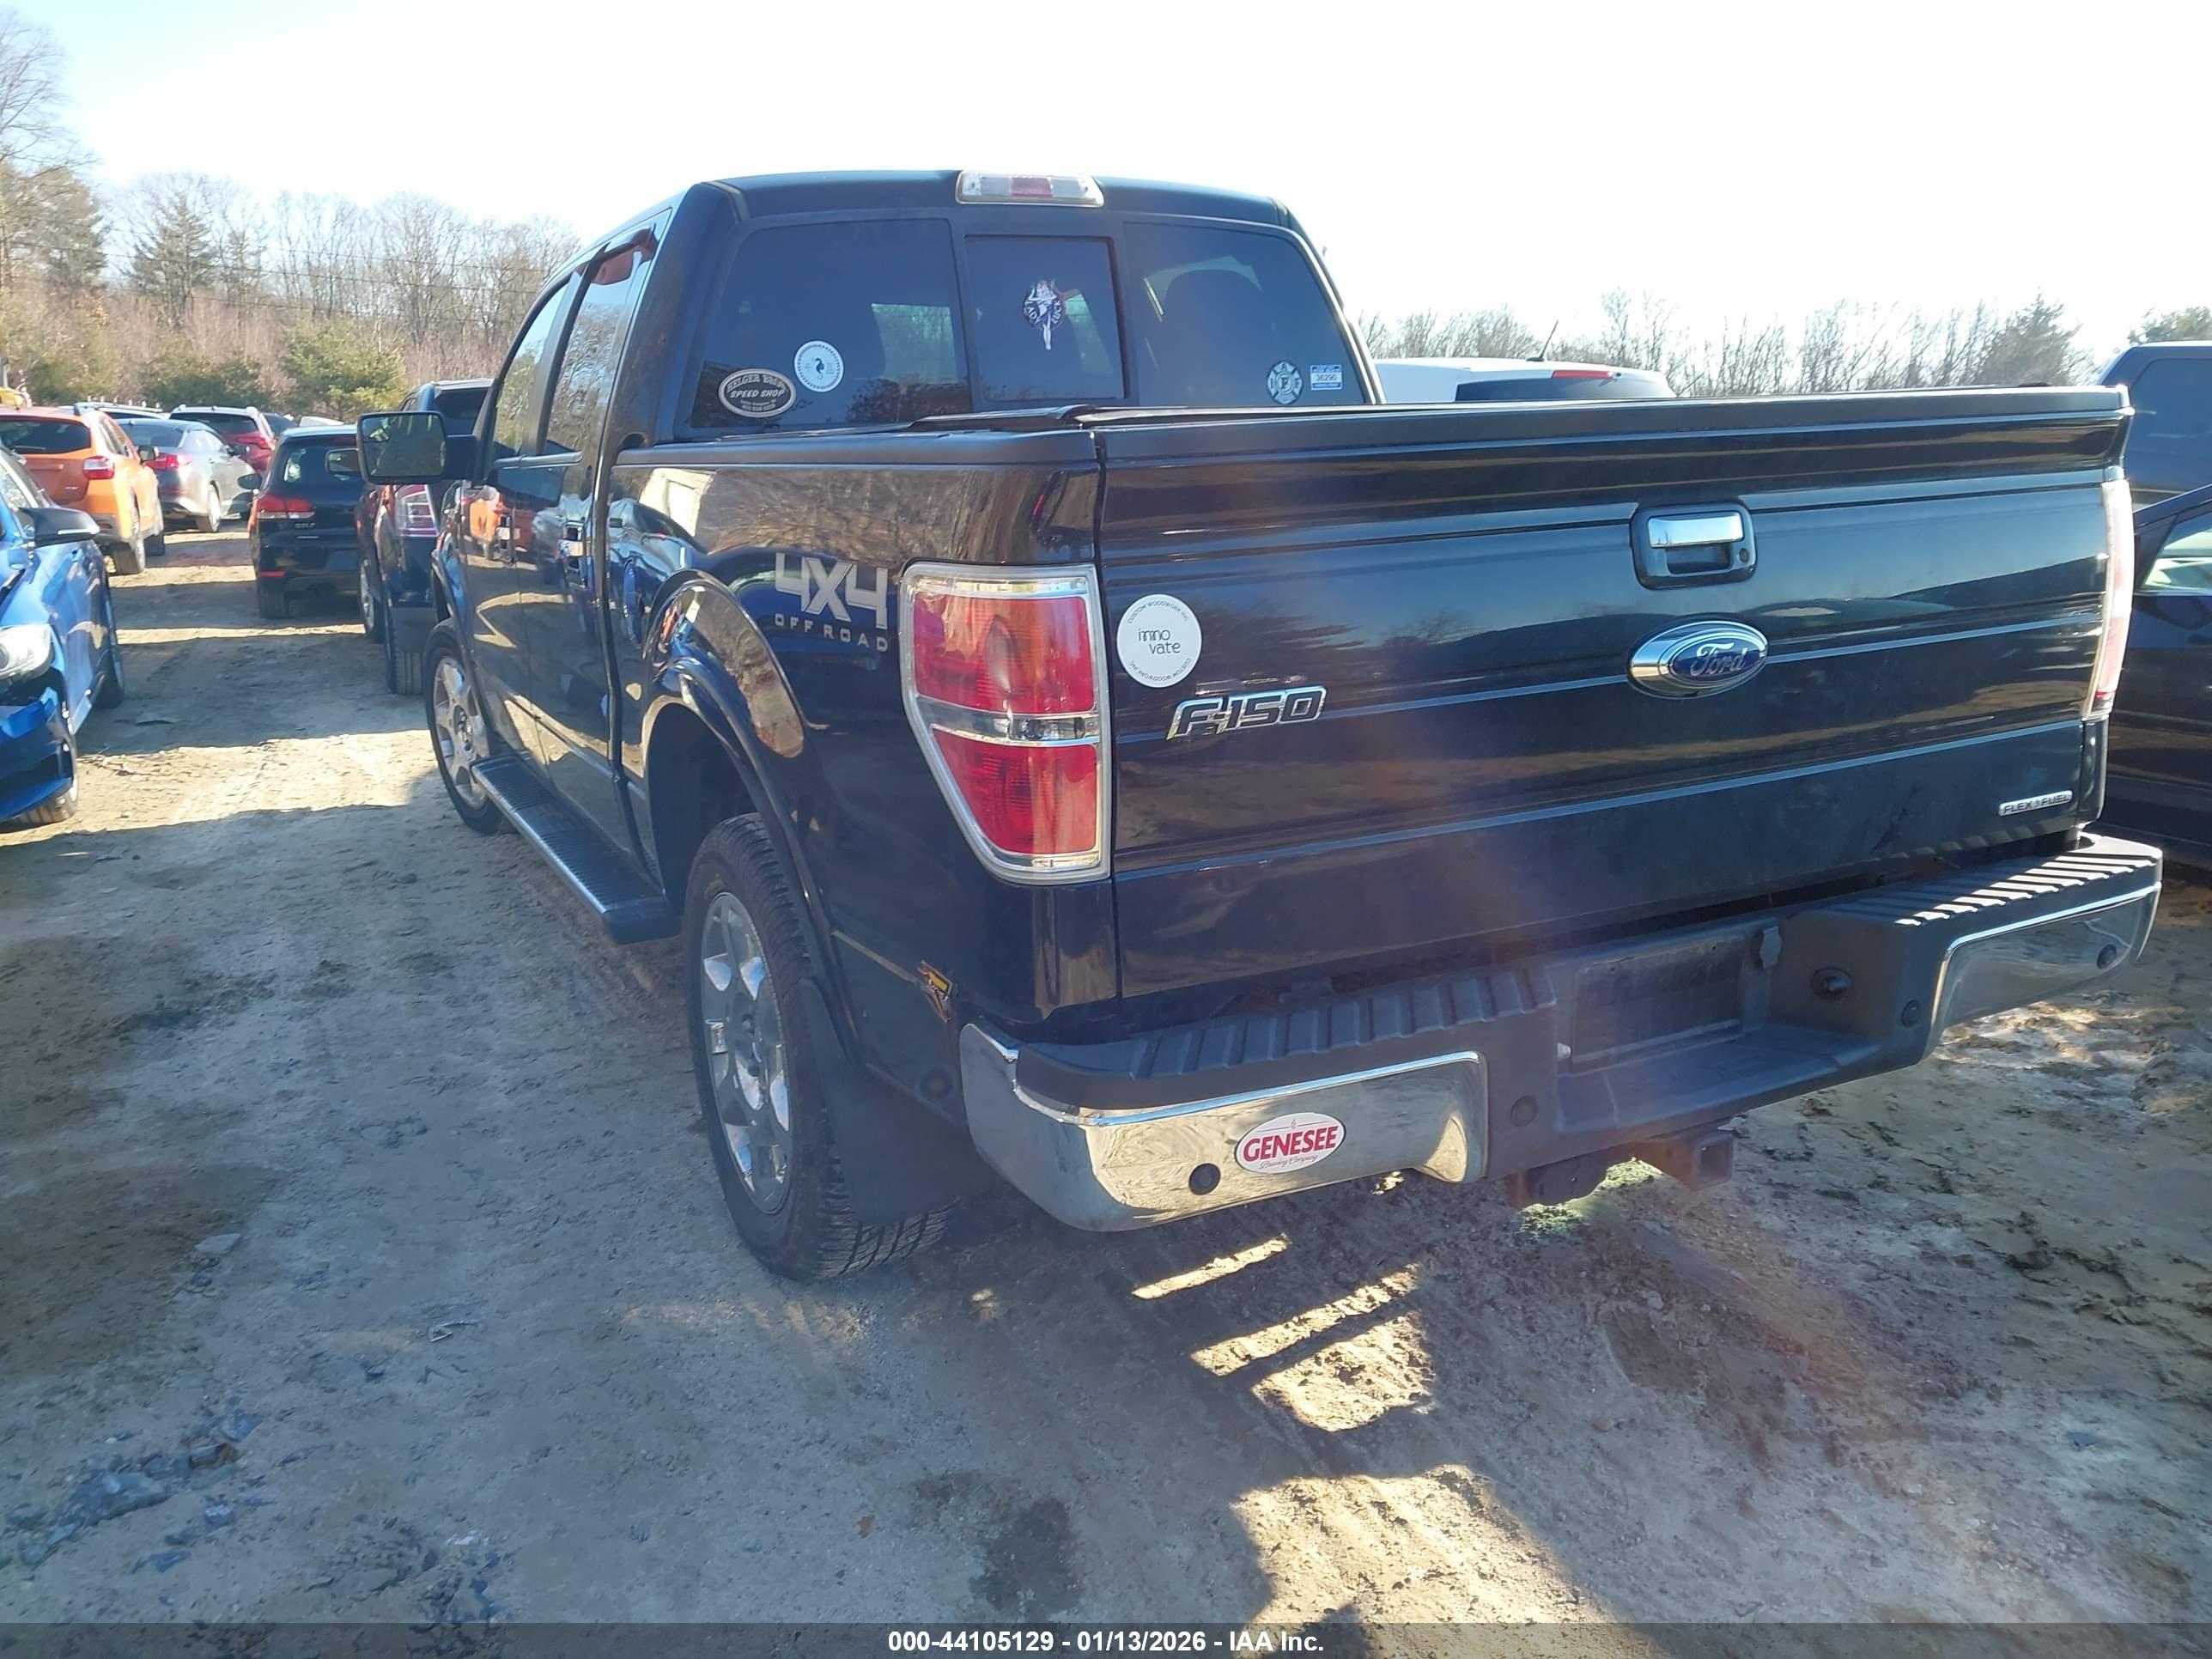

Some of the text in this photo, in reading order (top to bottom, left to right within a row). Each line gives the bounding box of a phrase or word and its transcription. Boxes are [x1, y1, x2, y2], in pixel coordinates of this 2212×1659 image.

[730, 389, 785, 398] SPEED SHOP
[775, 552, 888, 629] 4X4
[775, 613, 888, 652] OFF ROAD
[1149, 641, 1181, 654] vate
[1690, 642, 1748, 677] Ford
[1166, 686, 1327, 741] F-150
[2003, 794, 2069, 813] FLEX FUEL
[1243, 1126, 1340, 1162] GENESEE
